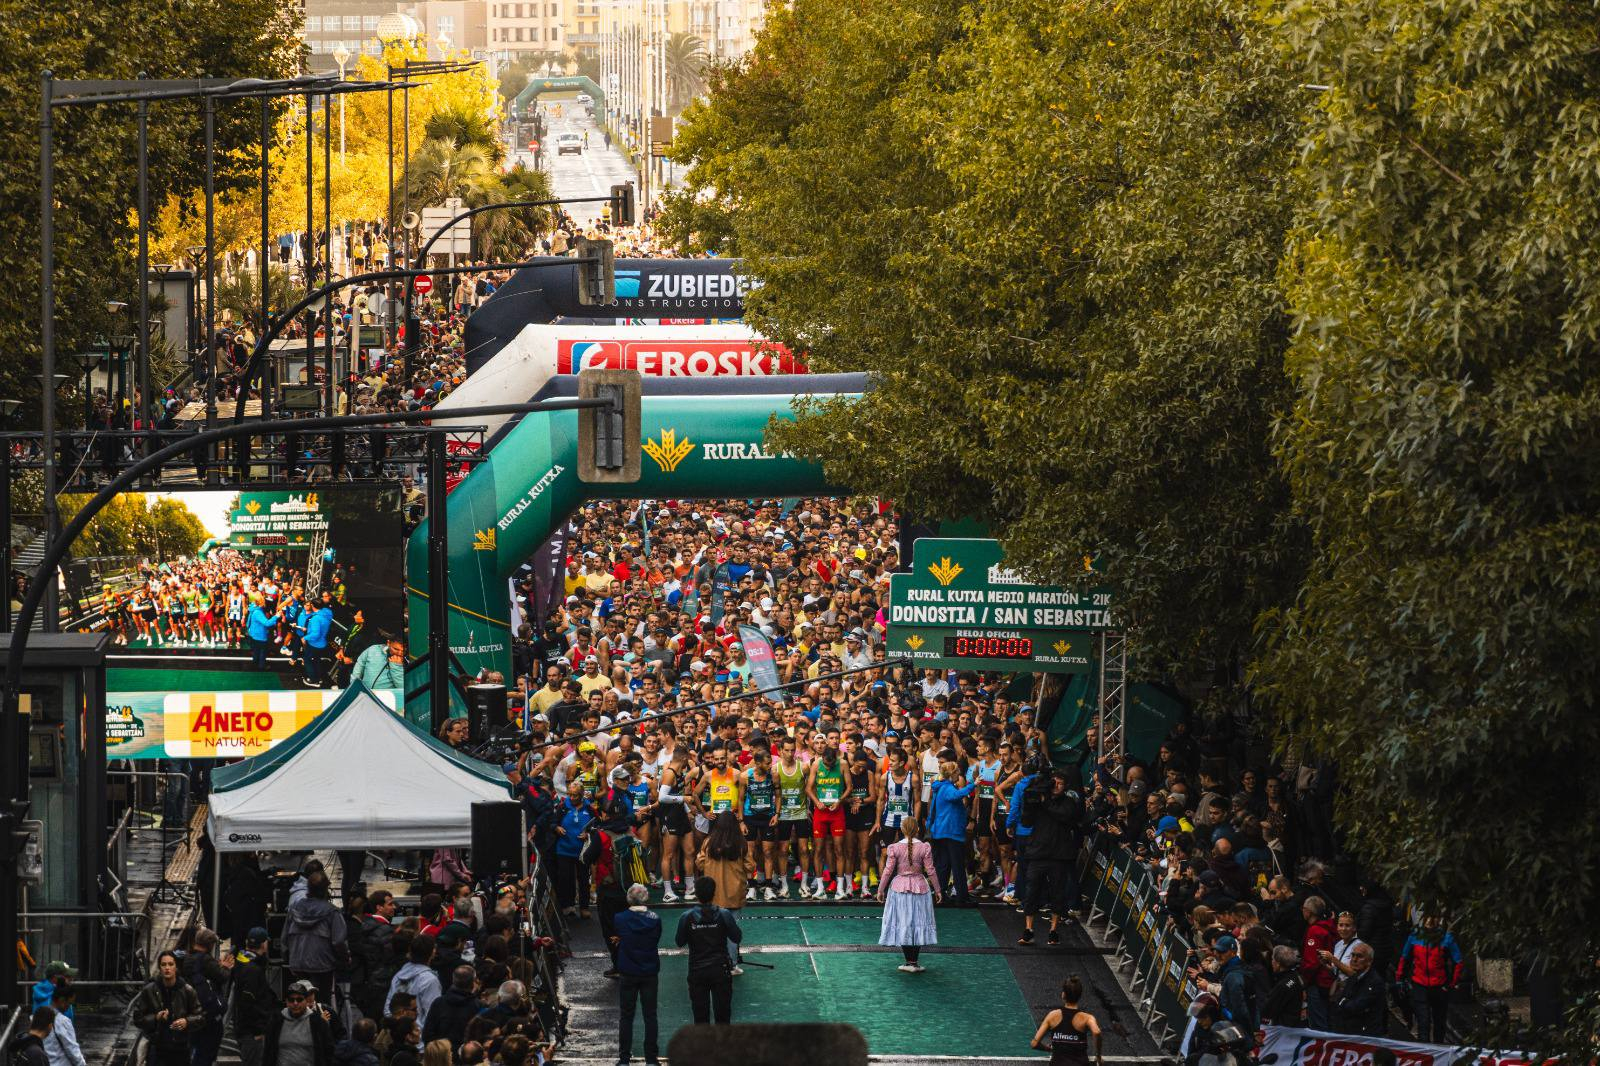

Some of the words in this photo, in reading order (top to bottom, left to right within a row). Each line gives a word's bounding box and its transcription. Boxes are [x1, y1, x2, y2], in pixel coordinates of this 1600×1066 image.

[636, 351, 780, 375] EROSKI
[497, 498, 532, 531] RURAL
[528, 464, 565, 500] KUTXA
[272, 522, 288, 530] SAN
[289, 520, 328, 530] SEBASTIÁN
[908, 589, 944, 602] RURAL
[948, 590, 984, 602] KUTXA
[988, 591, 1024, 604] MEDIO
[1028, 590, 1079, 605] MARATÓN
[1092, 593, 1111, 606] 21K
[892, 605, 976, 624] DONOSTIA
[981, 606, 988, 624] /
[994, 607, 1028, 625] SAN
[956, 630, 984, 638] RELOJ
[986, 630, 1020, 639] OFICIAL
[448, 645, 477, 654] RURAL
[479, 644, 504, 652] KUTXA
[956, 638, 1033, 656] 0:00:00
[914, 651, 940, 659] KUTXA
[1035, 655, 1060, 663] RURAL
[192, 706, 273, 732] ANETO
[110, 728, 144, 737] SEBASTIÁN
[205, 737, 262, 748] NATURAL
